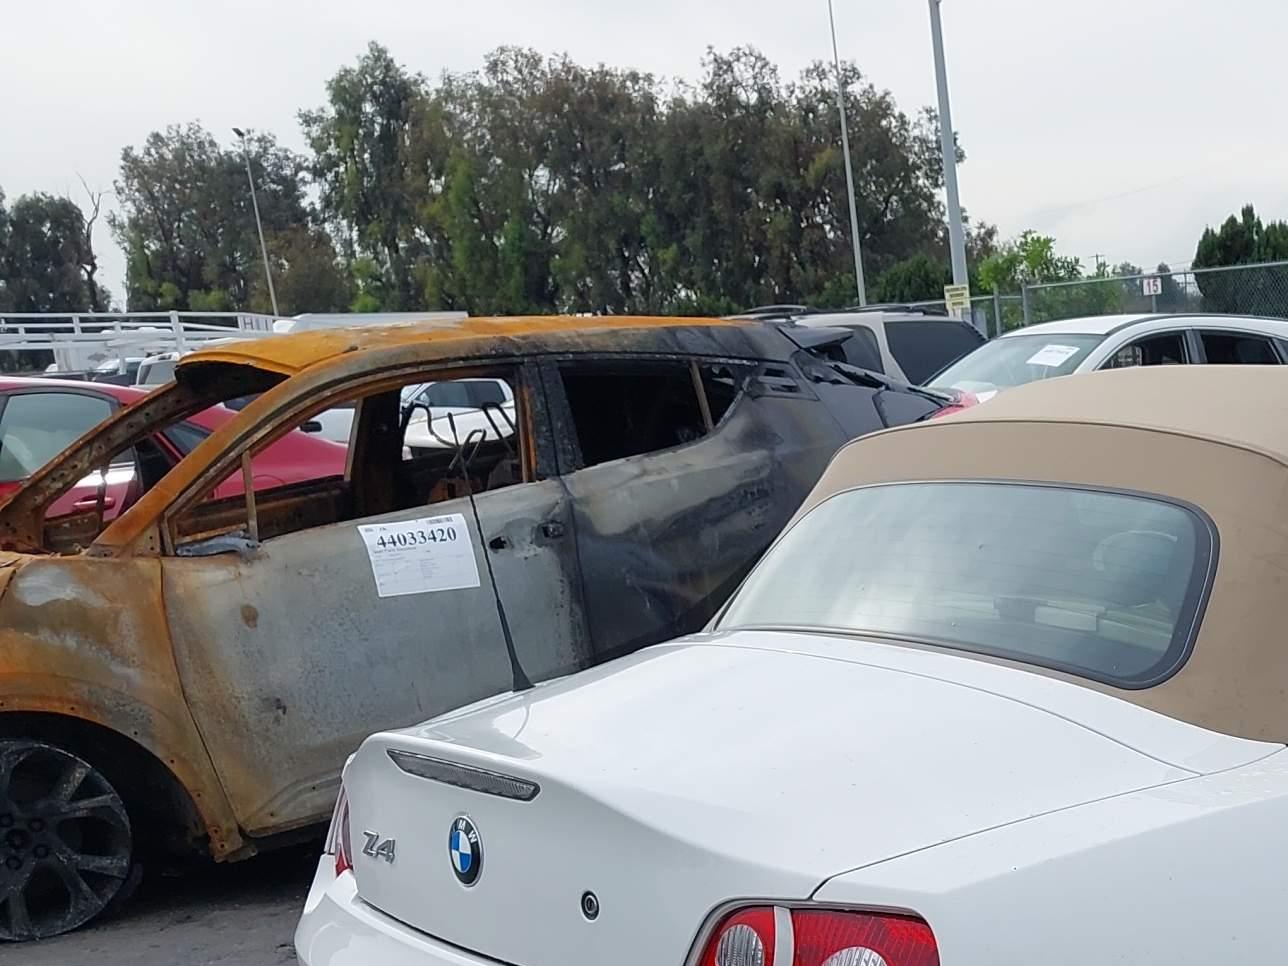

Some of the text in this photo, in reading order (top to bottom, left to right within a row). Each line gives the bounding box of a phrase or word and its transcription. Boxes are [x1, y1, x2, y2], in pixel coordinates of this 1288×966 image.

[1146, 279, 1159, 294] 15
[376, 526, 458, 549] 44033420
[361, 830, 396, 864] Z4
